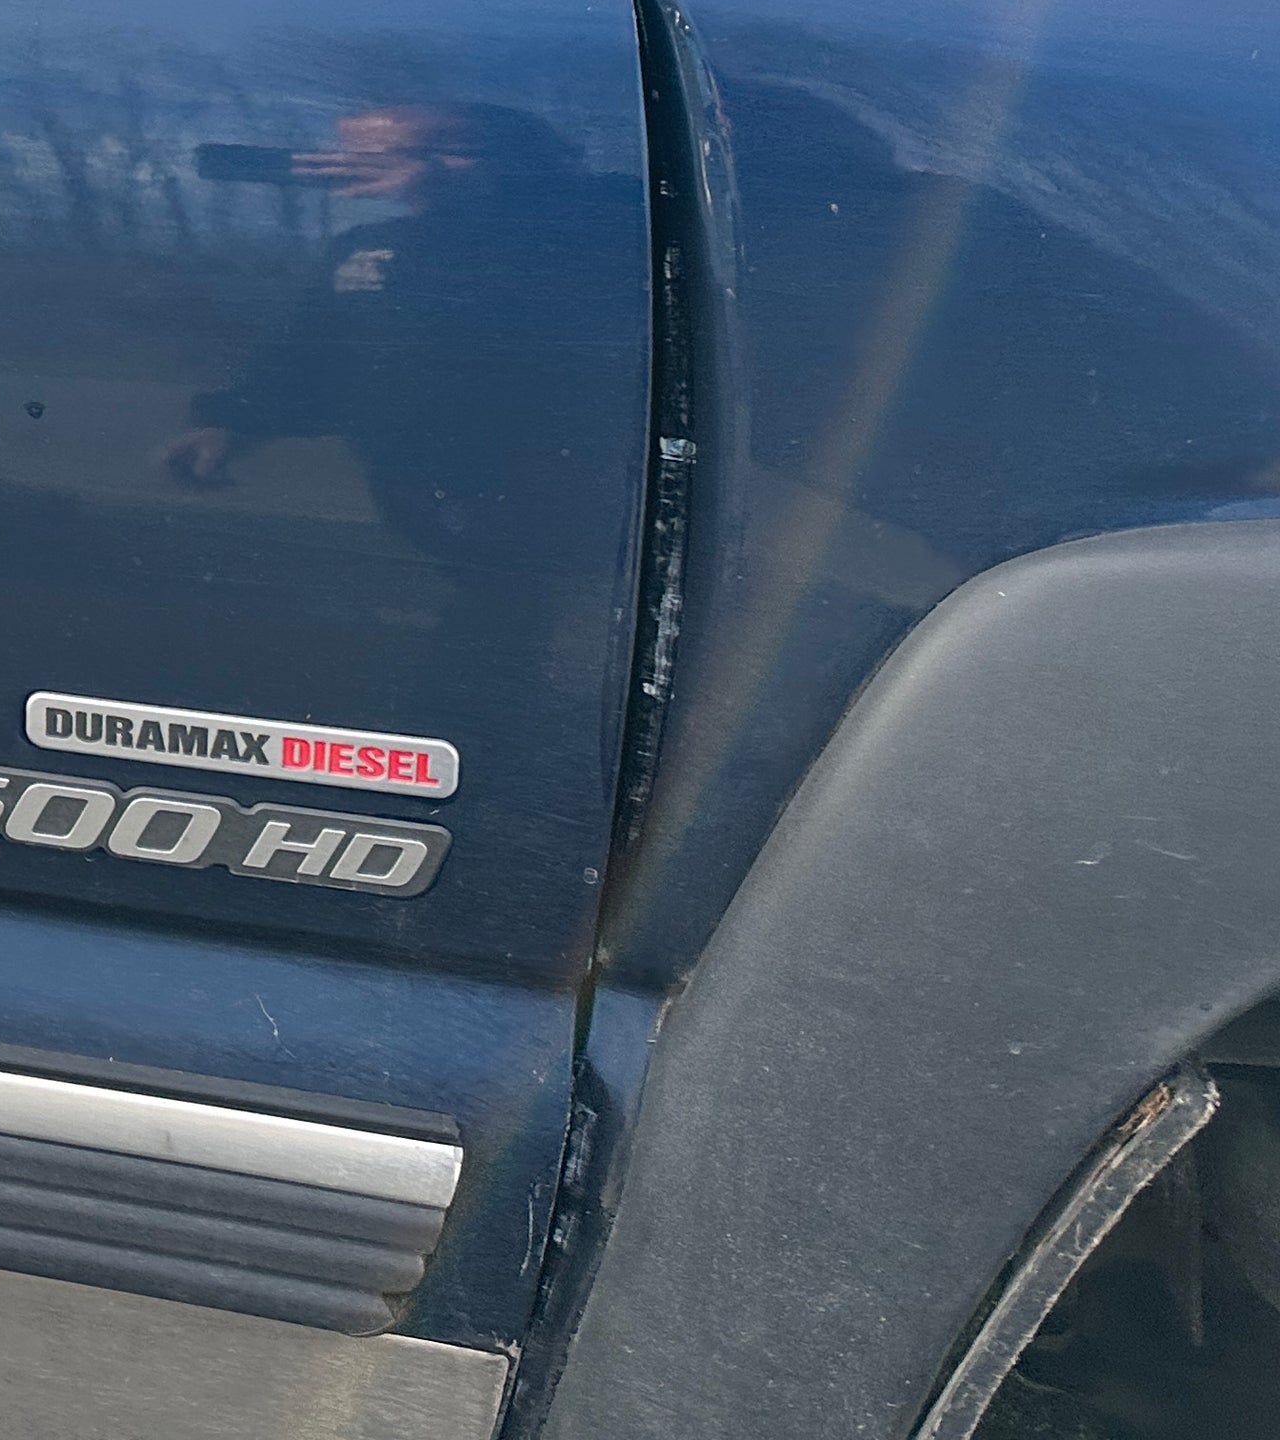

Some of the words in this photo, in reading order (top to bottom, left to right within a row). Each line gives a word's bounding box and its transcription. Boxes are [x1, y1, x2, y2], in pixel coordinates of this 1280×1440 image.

[46, 707, 269, 766] DURAMAX
[281, 736, 439, 786] DIESEL
[241, 821, 428, 888] HD
